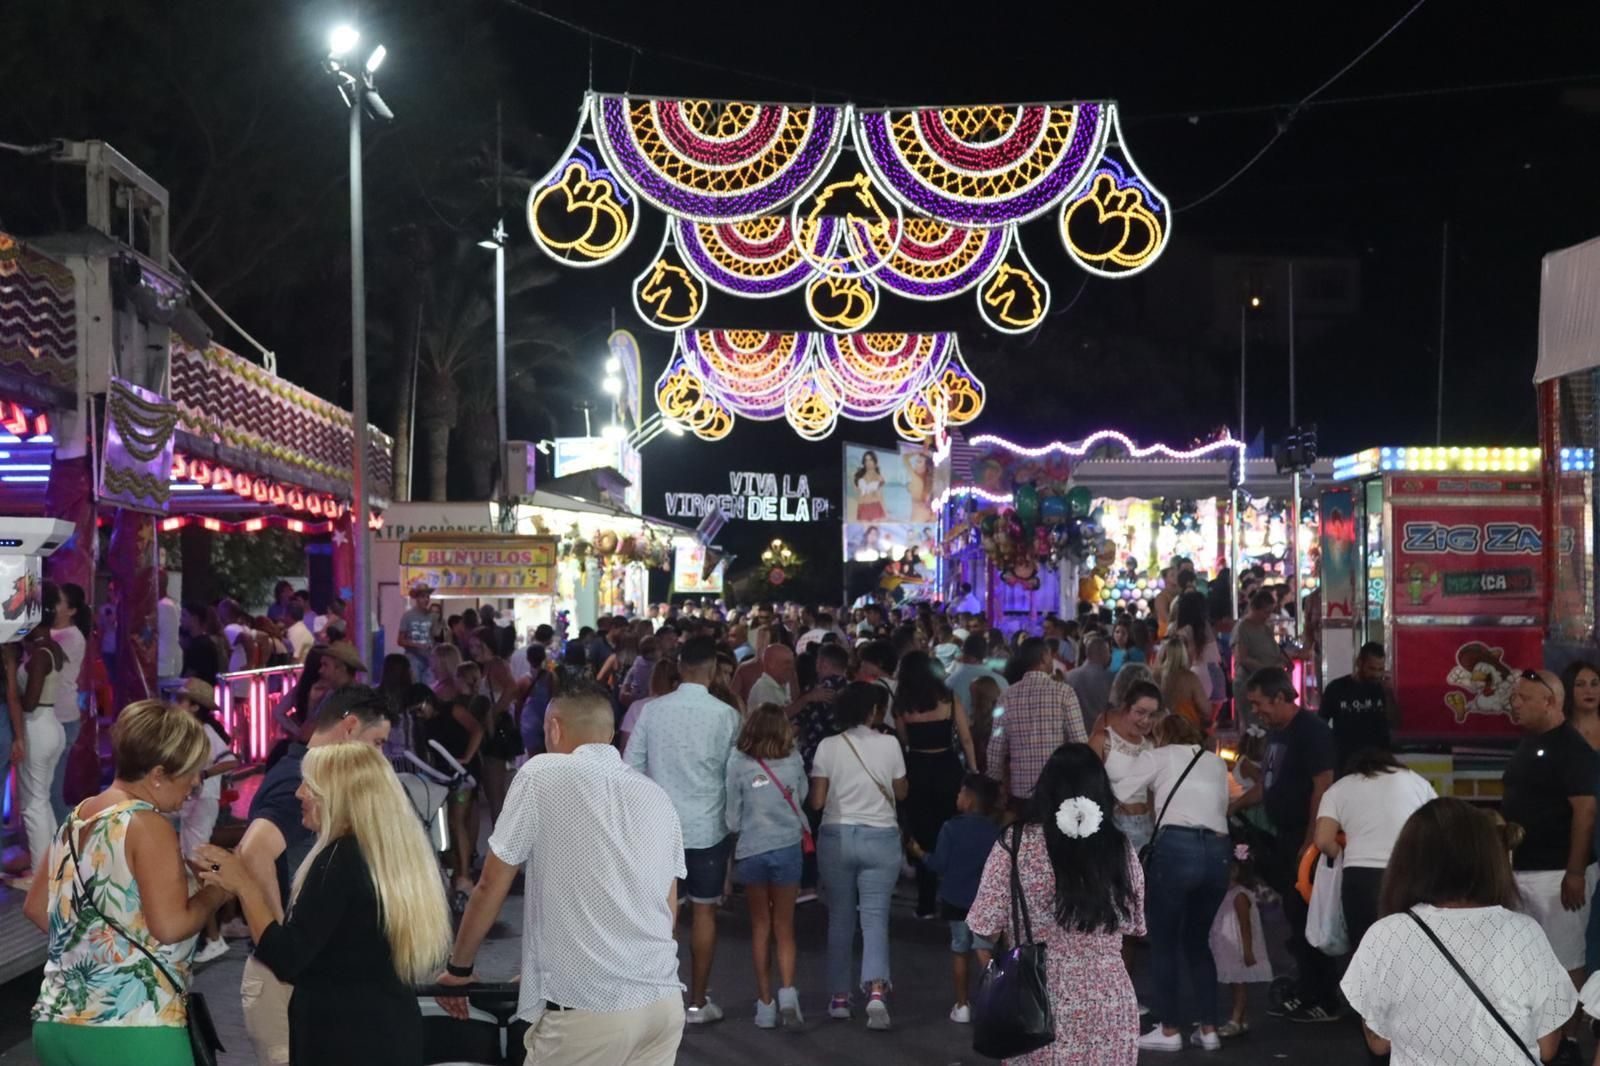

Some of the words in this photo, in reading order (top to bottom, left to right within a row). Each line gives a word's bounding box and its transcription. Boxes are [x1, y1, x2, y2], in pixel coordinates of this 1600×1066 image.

[729, 471, 778, 496] VIVA
[782, 474, 810, 498] LA
[747, 496, 778, 521] DE
[780, 497, 810, 521] LA
